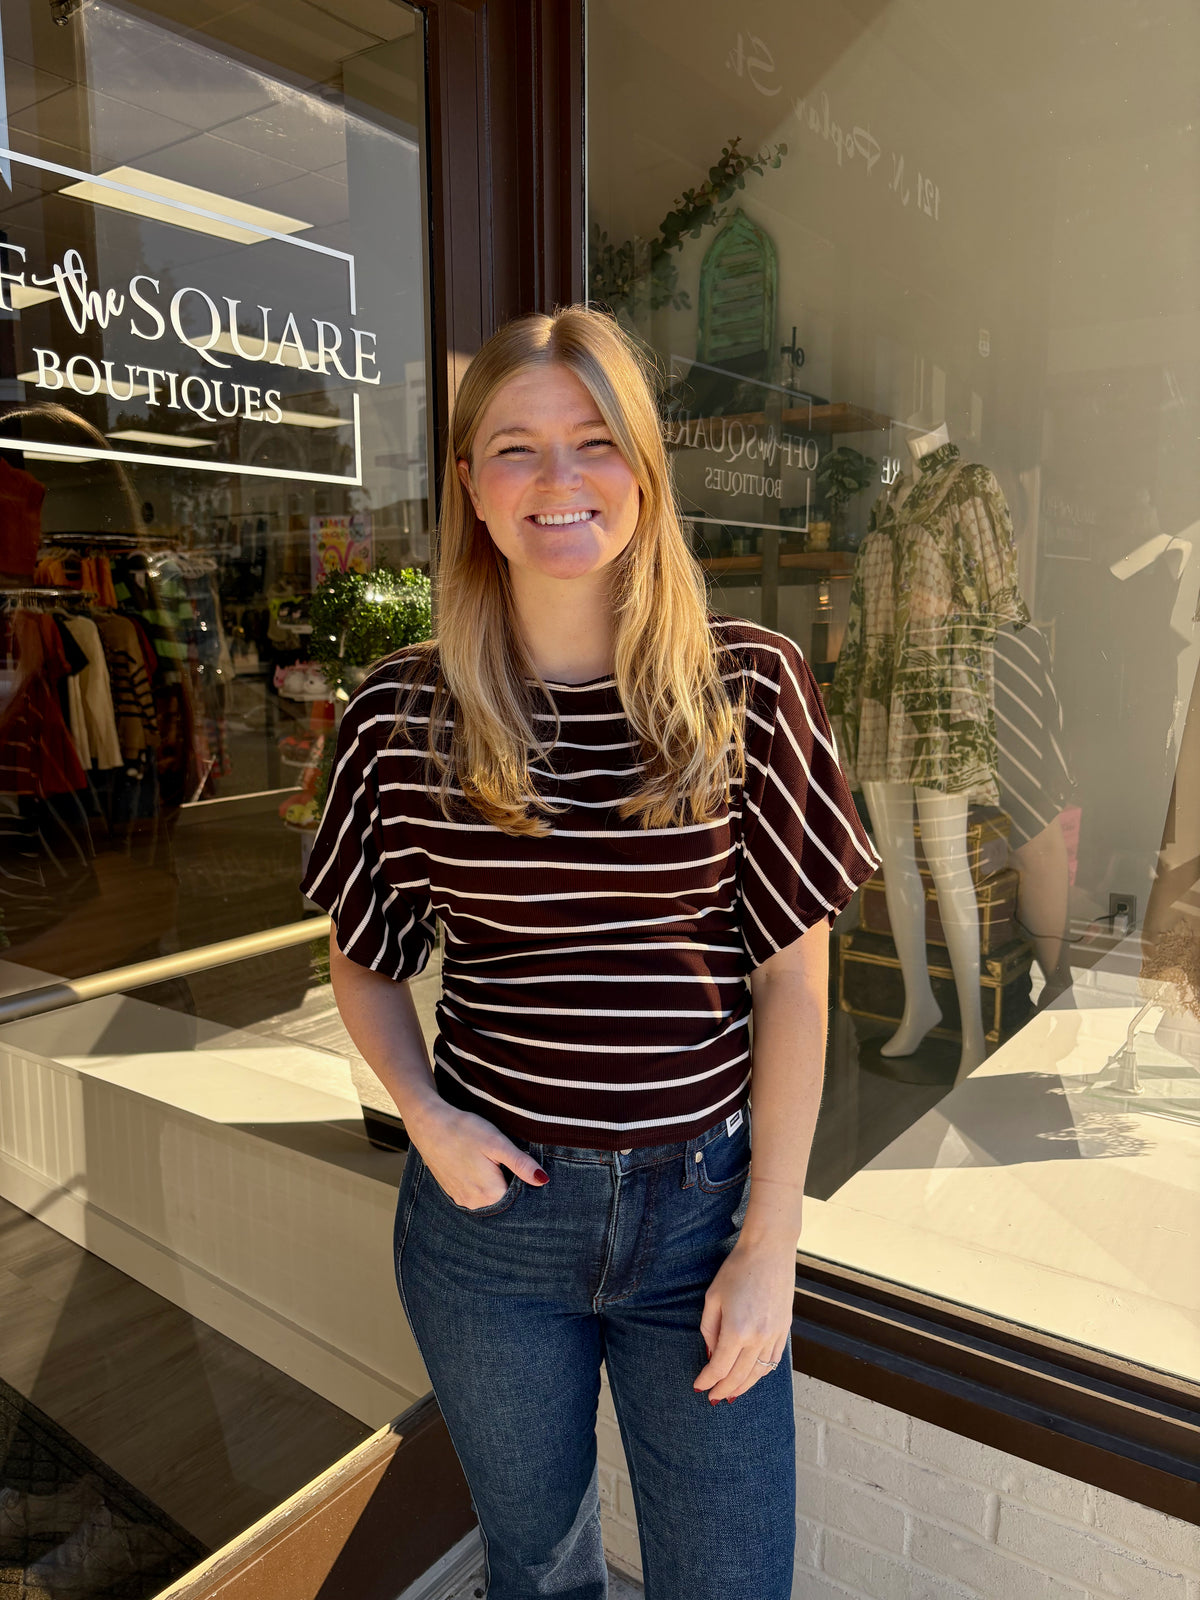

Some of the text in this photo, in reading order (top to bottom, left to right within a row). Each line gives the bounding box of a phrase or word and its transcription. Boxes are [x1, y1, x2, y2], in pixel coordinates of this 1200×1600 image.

[31, 249, 125, 334] the
[129, 275, 381, 385] SQUARE
[32, 347, 283, 424] BOUTIQUES
